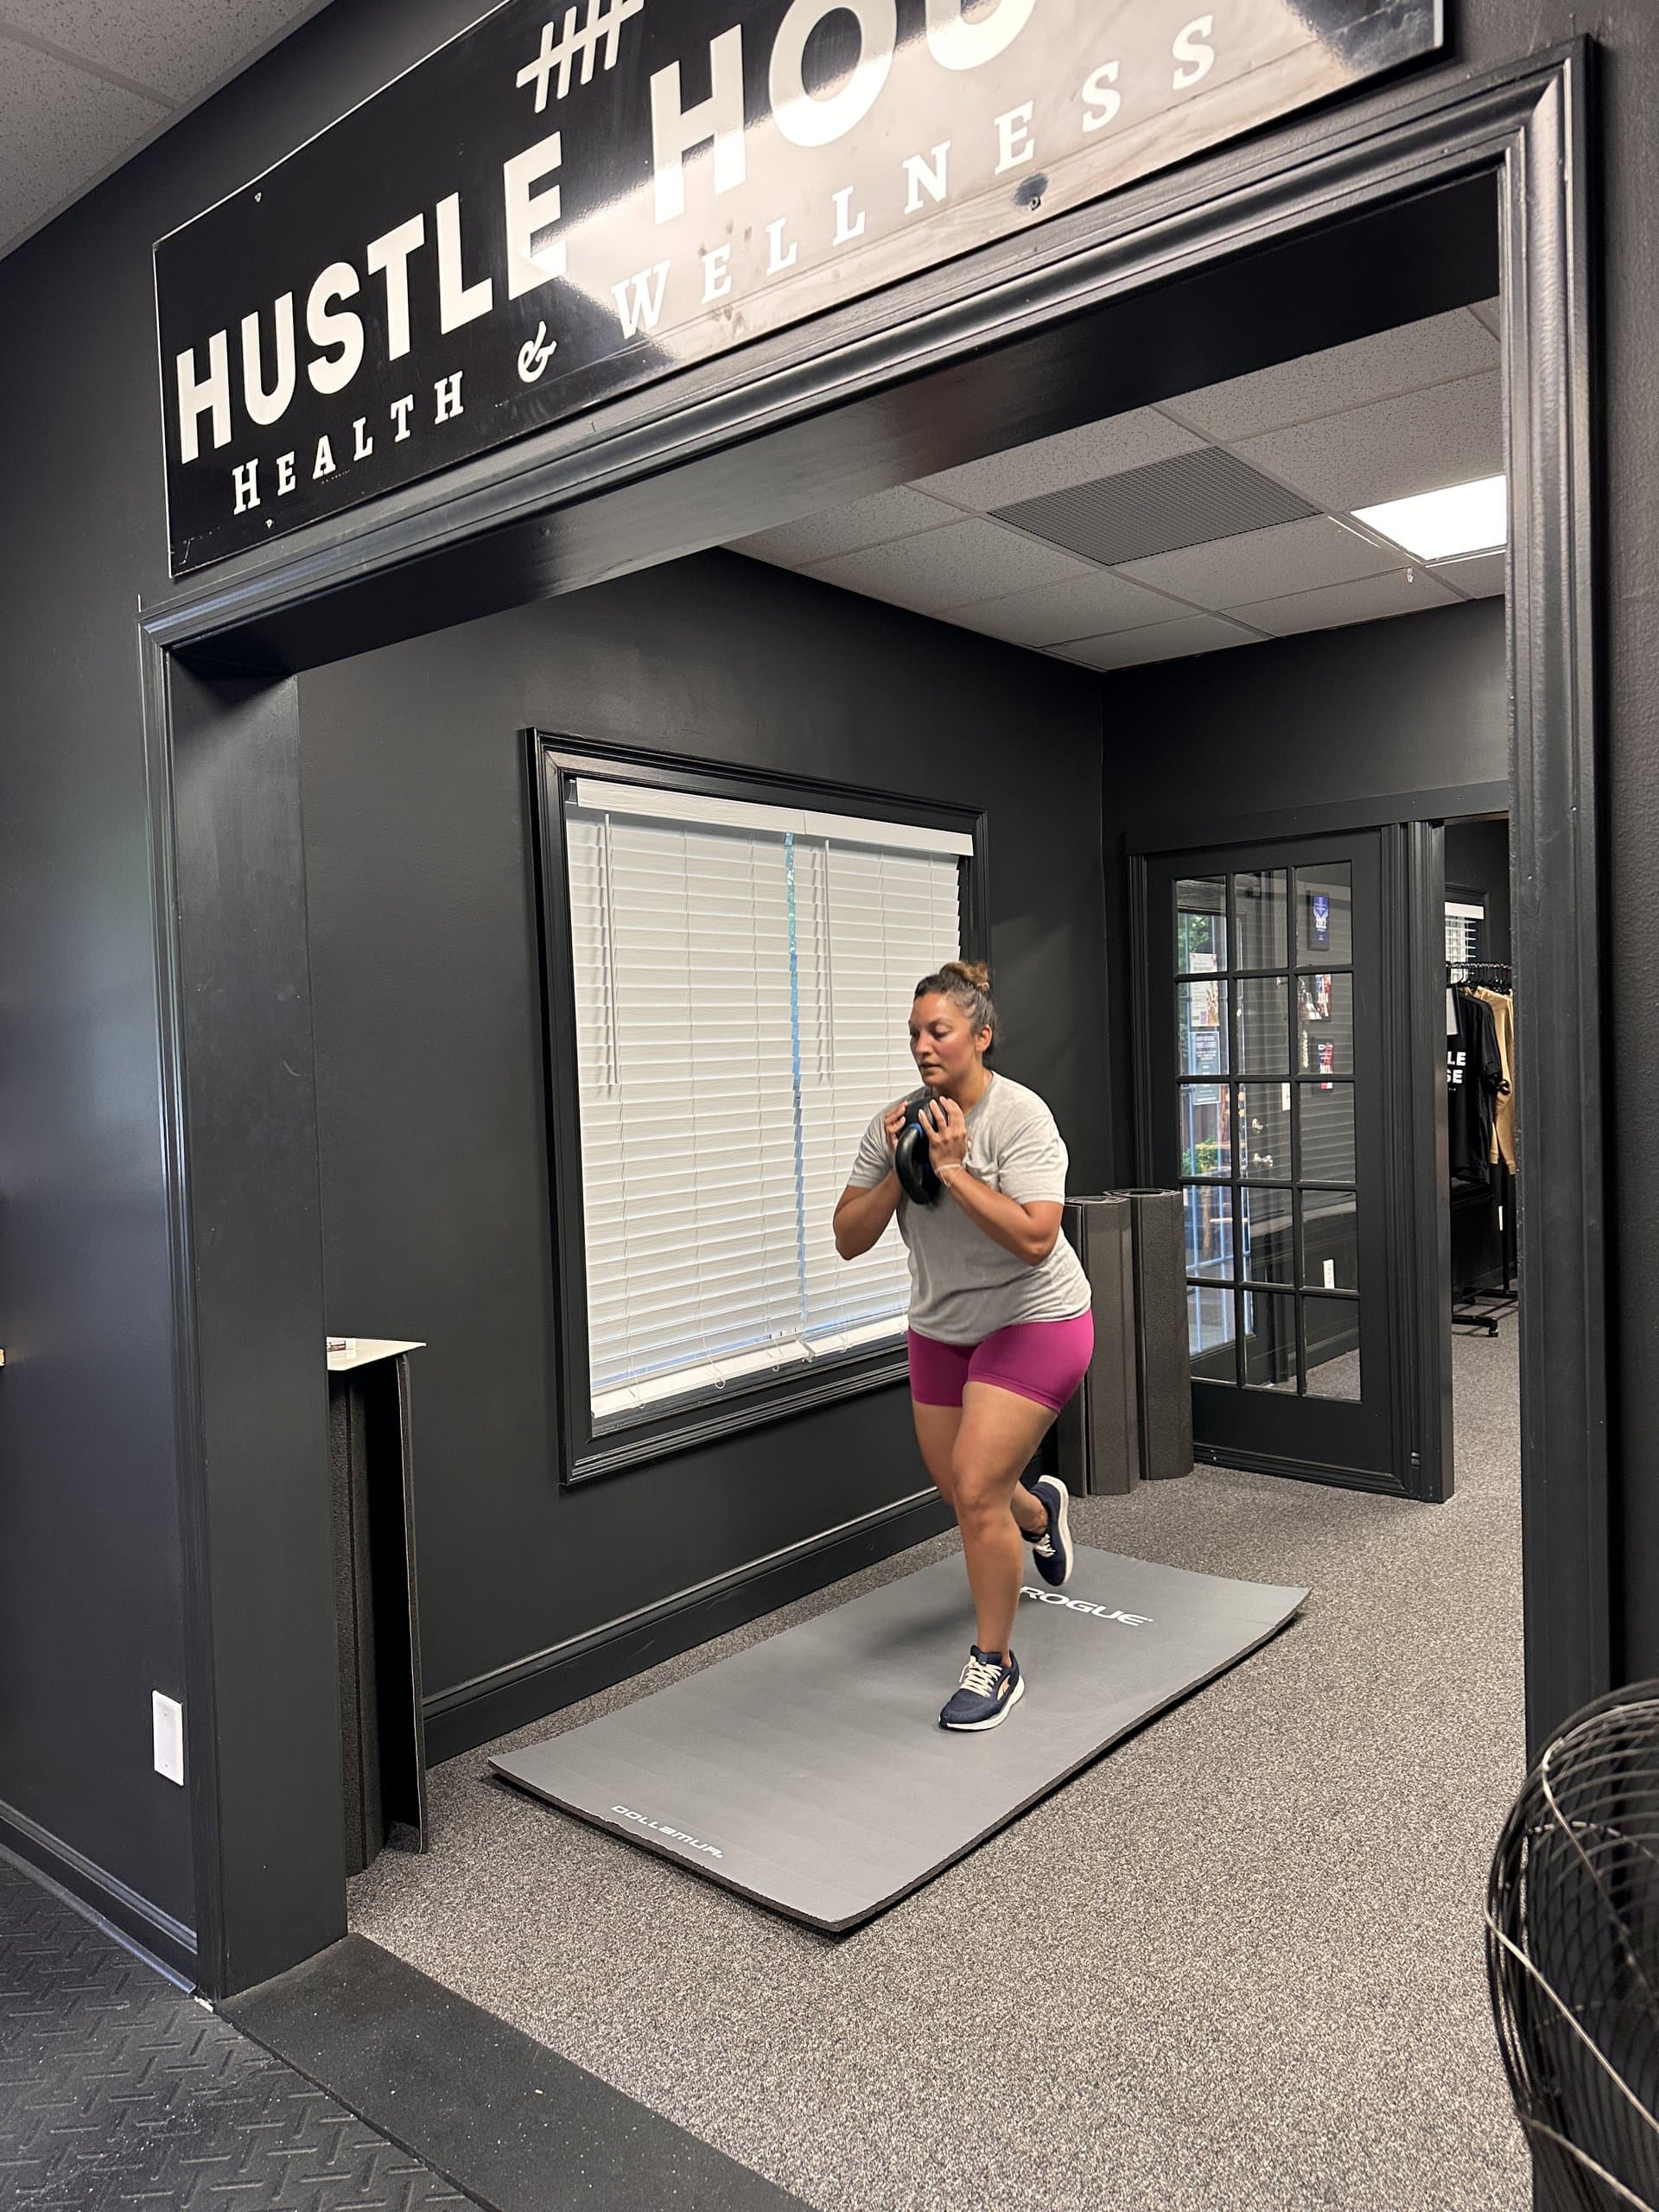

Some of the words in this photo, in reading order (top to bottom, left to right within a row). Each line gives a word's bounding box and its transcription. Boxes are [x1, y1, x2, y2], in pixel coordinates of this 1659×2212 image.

[231, 371, 465, 516] HEALTH
[518, 321, 557, 384] &
[612, 15, 1216, 340] WELLNESS
[175, 130, 567, 465] HUSTLE
[1447, 1051, 1466, 1066] LE
[1020, 1586, 1150, 1626] ROGUE
[611, 1805, 724, 1858] DOLLAMUR
